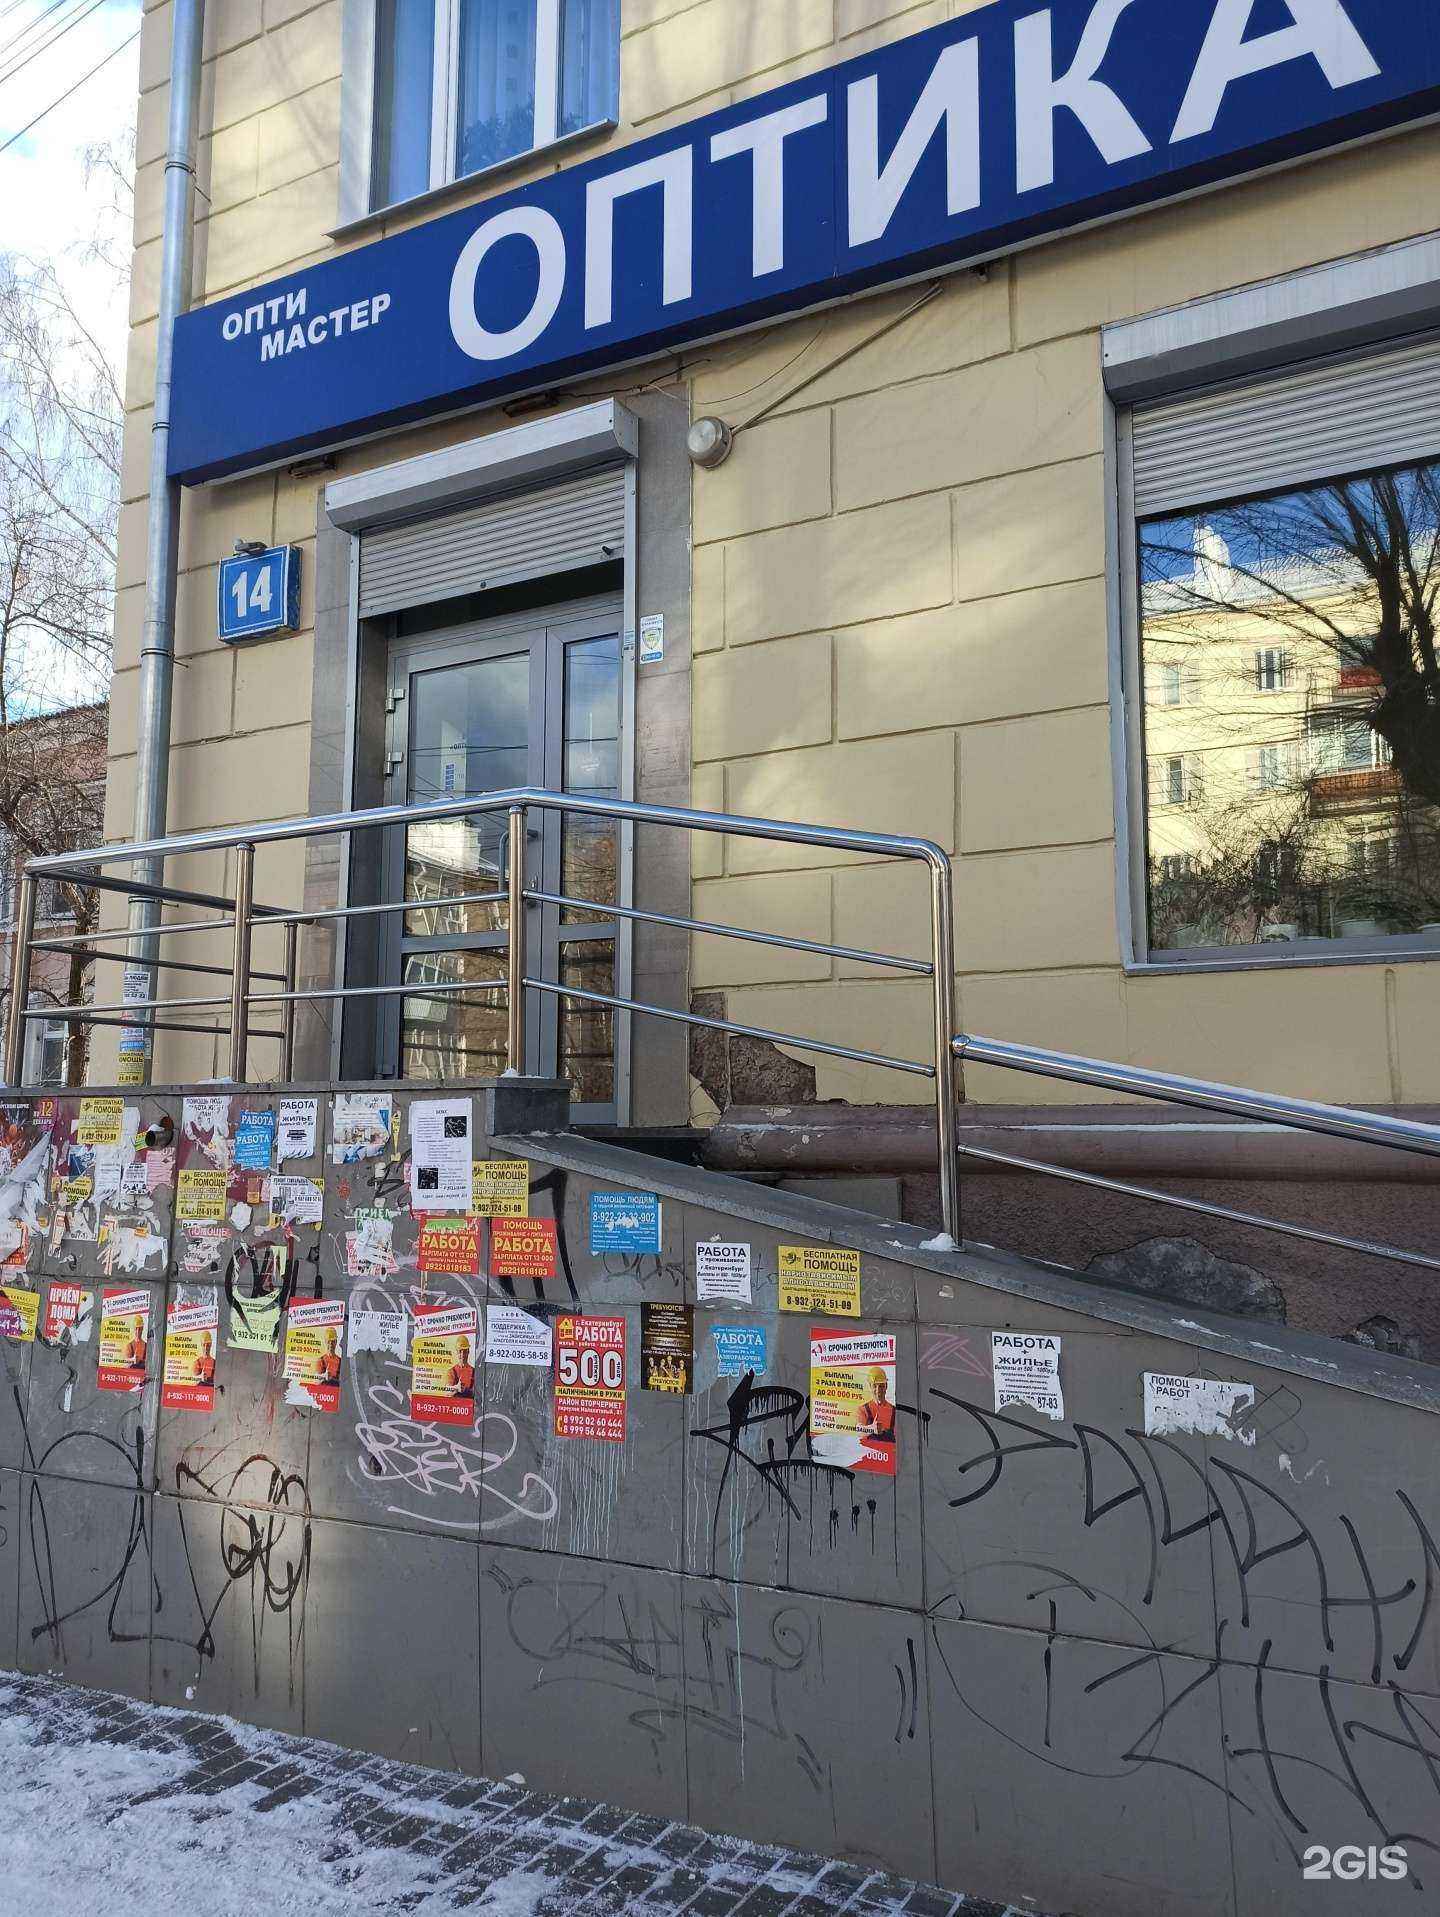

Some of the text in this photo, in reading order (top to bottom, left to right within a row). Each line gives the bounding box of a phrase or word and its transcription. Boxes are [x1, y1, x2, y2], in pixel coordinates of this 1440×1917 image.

[449, 0, 1383, 361] ОПТИКА
[222, 287, 308, 341] ОПТИ
[260, 293, 391, 362] МАСТЕР
[231, 565, 273, 618] 14
[93, 1105, 123, 1114] ПОМОЩЬ
[280, 1100, 315, 1110] РАБОТА
[241, 1115, 274, 1126] РАБОТА
[236, 1134, 270, 1145] РАБОТА
[485, 1171, 527, 1181] ПОМОЩЬ
[193, 1178, 226, 1188] ПОМОЩЬ
[593, 1195, 655, 1204] ПОМОЩЬ ЛЮДЯМ
[503, 1220, 543, 1231] ПОМОЩЬ
[421, 1234, 477, 1251] РАБОТА
[494, 1237, 553, 1254] РАБОТА
[697, 1246, 747, 1257] РАБОТА
[803, 1250, 858, 1261] БЕСПЛАТНАЯ
[803, 1259, 858, 1273] ПОМОЩЬ
[50, 1286, 80, 1304] ПРИЁМ
[786, 1295, 852, 1310] 8-932-124-51-09
[50, 1304, 76, 1321] ЛОМА
[575, 1326, 623, 1343] РАБОТА
[712, 1332, 764, 1346] РАБОТА
[828, 1340, 888, 1352] СРОЧНО ТРЕБУЮТСЯ
[993, 1335, 1056, 1351] РАБОТА
[489, 1348, 549, 1360] 8-922-036-58-58
[997, 1356, 1053, 1367] ЖИЛЬЕ
[558, 1348, 623, 1388] 500
[824, 1371, 854, 1381] ВЫПЛАТЫ
[821, 1379, 836, 1387] РАЗА
[843, 1382, 864, 1391] МЕСЯЦ
[557, 1388, 598, 1396] НАЛИЧНЫМИ
[605, 1390, 622, 1398] РУКИ
[816, 1389, 826, 1397] ДО
[826, 1389, 836, 1397] 20
[837, 1390, 850, 1399] 000
[1156, 1386, 1192, 1399] РАБОТ
[558, 1397, 580, 1406] РАЙОН
[416, 1403, 469, 1415] 8-932-117-0000
[585, 1416, 595, 1426] 02
